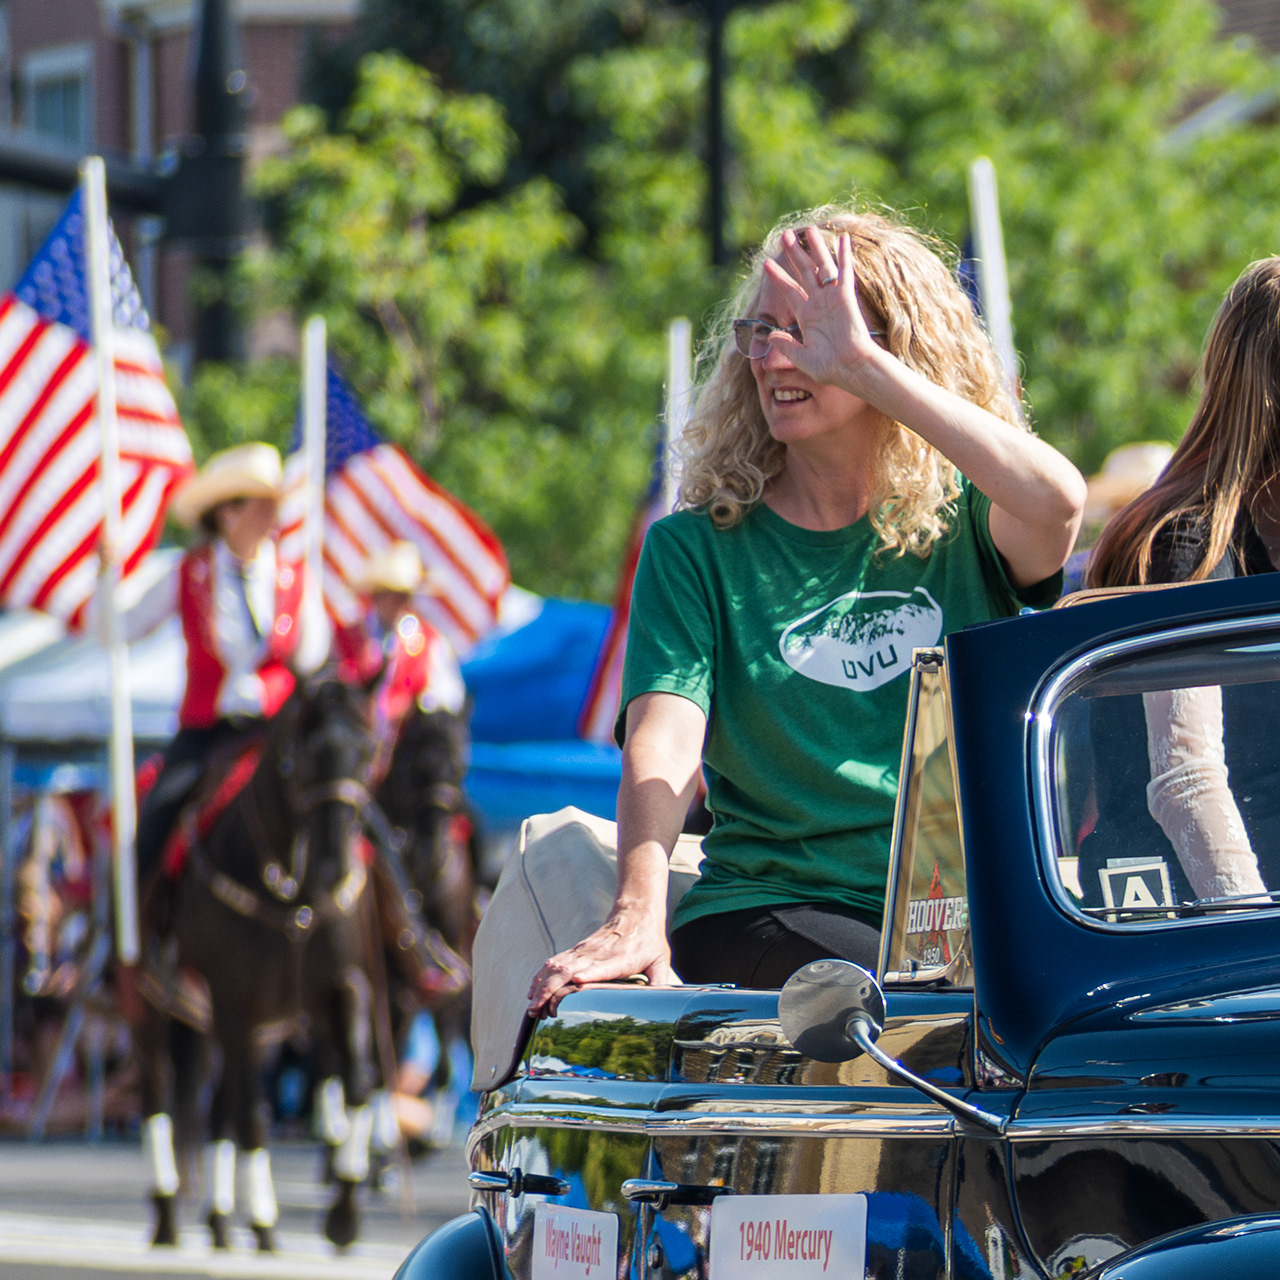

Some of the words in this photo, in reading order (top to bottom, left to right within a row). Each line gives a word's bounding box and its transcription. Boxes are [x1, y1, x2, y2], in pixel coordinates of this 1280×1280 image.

[841, 644, 898, 679] UVU
[1122, 876, 1159, 907] A
[906, 896, 963, 935] HOOVER
[545, 1217, 569, 1270] Wayne
[571, 1221, 601, 1276] Vaught
[739, 1221, 771, 1261] 1940
[773, 1219, 833, 1273] Mercury
